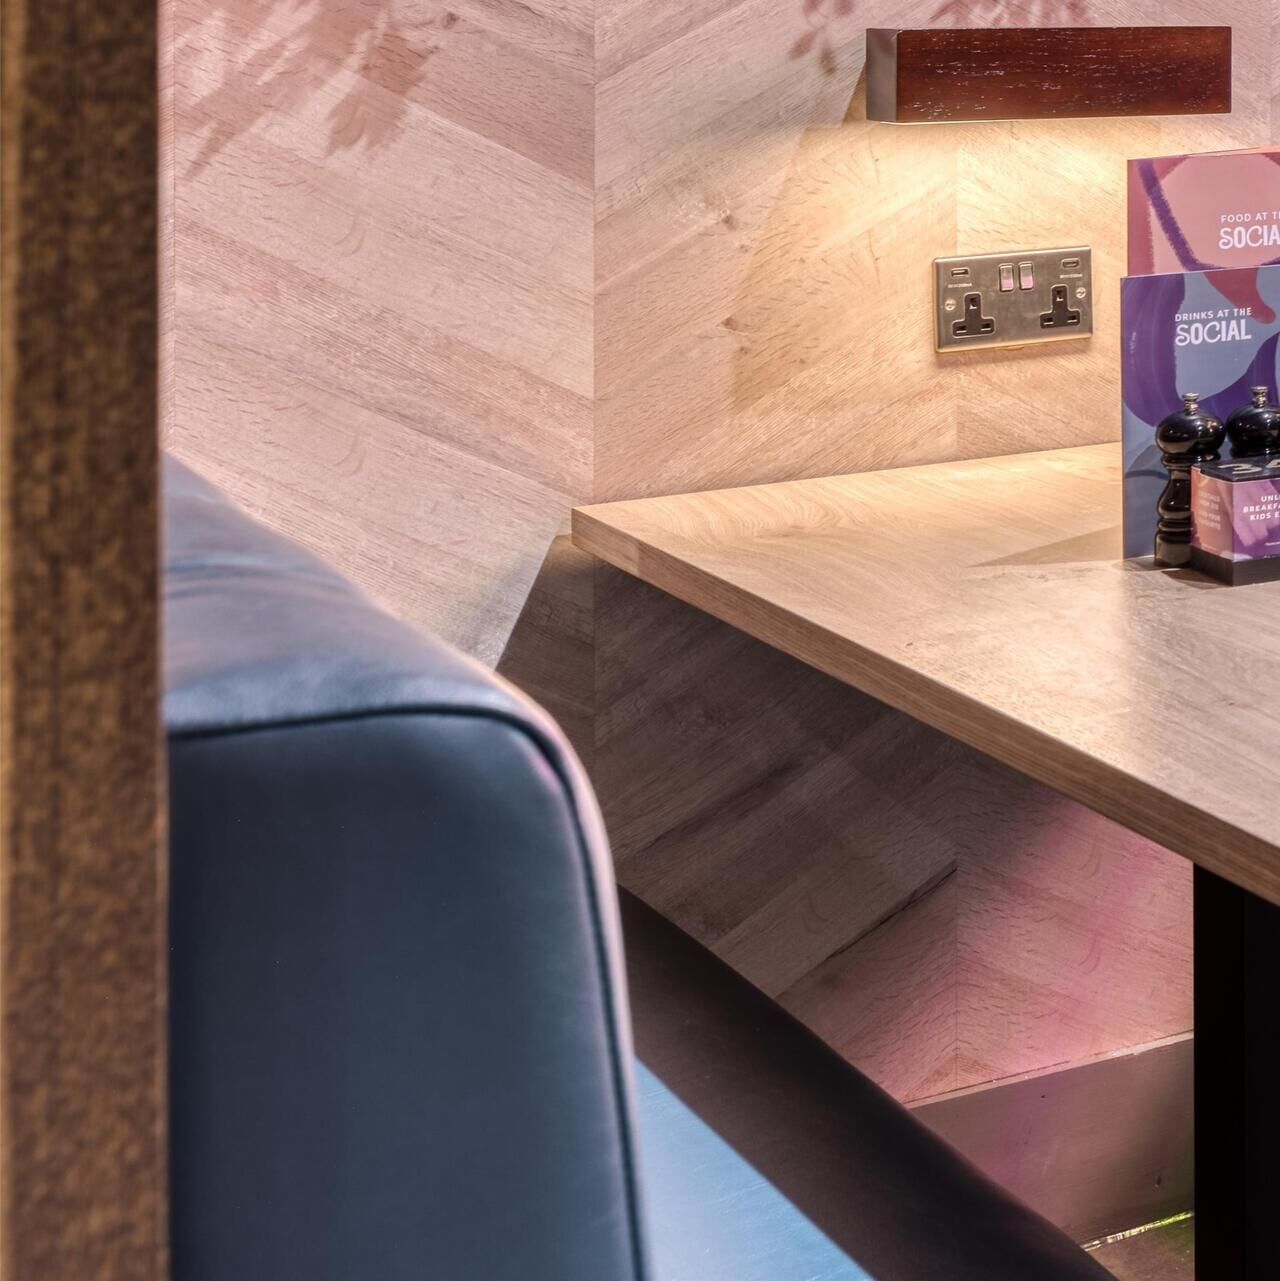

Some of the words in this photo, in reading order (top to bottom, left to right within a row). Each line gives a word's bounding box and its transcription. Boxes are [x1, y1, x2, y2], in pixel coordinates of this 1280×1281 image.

[1220, 213, 1251, 224] FOOD
[1255, 212, 1267, 221] AT
[1175, 311, 1214, 322] DRINKS
[1216, 309, 1229, 318] AT
[1233, 307, 1252, 316] THE
[1175, 319, 1252, 346] SOCIAL
[1249, 513, 1272, 521] KIDS
